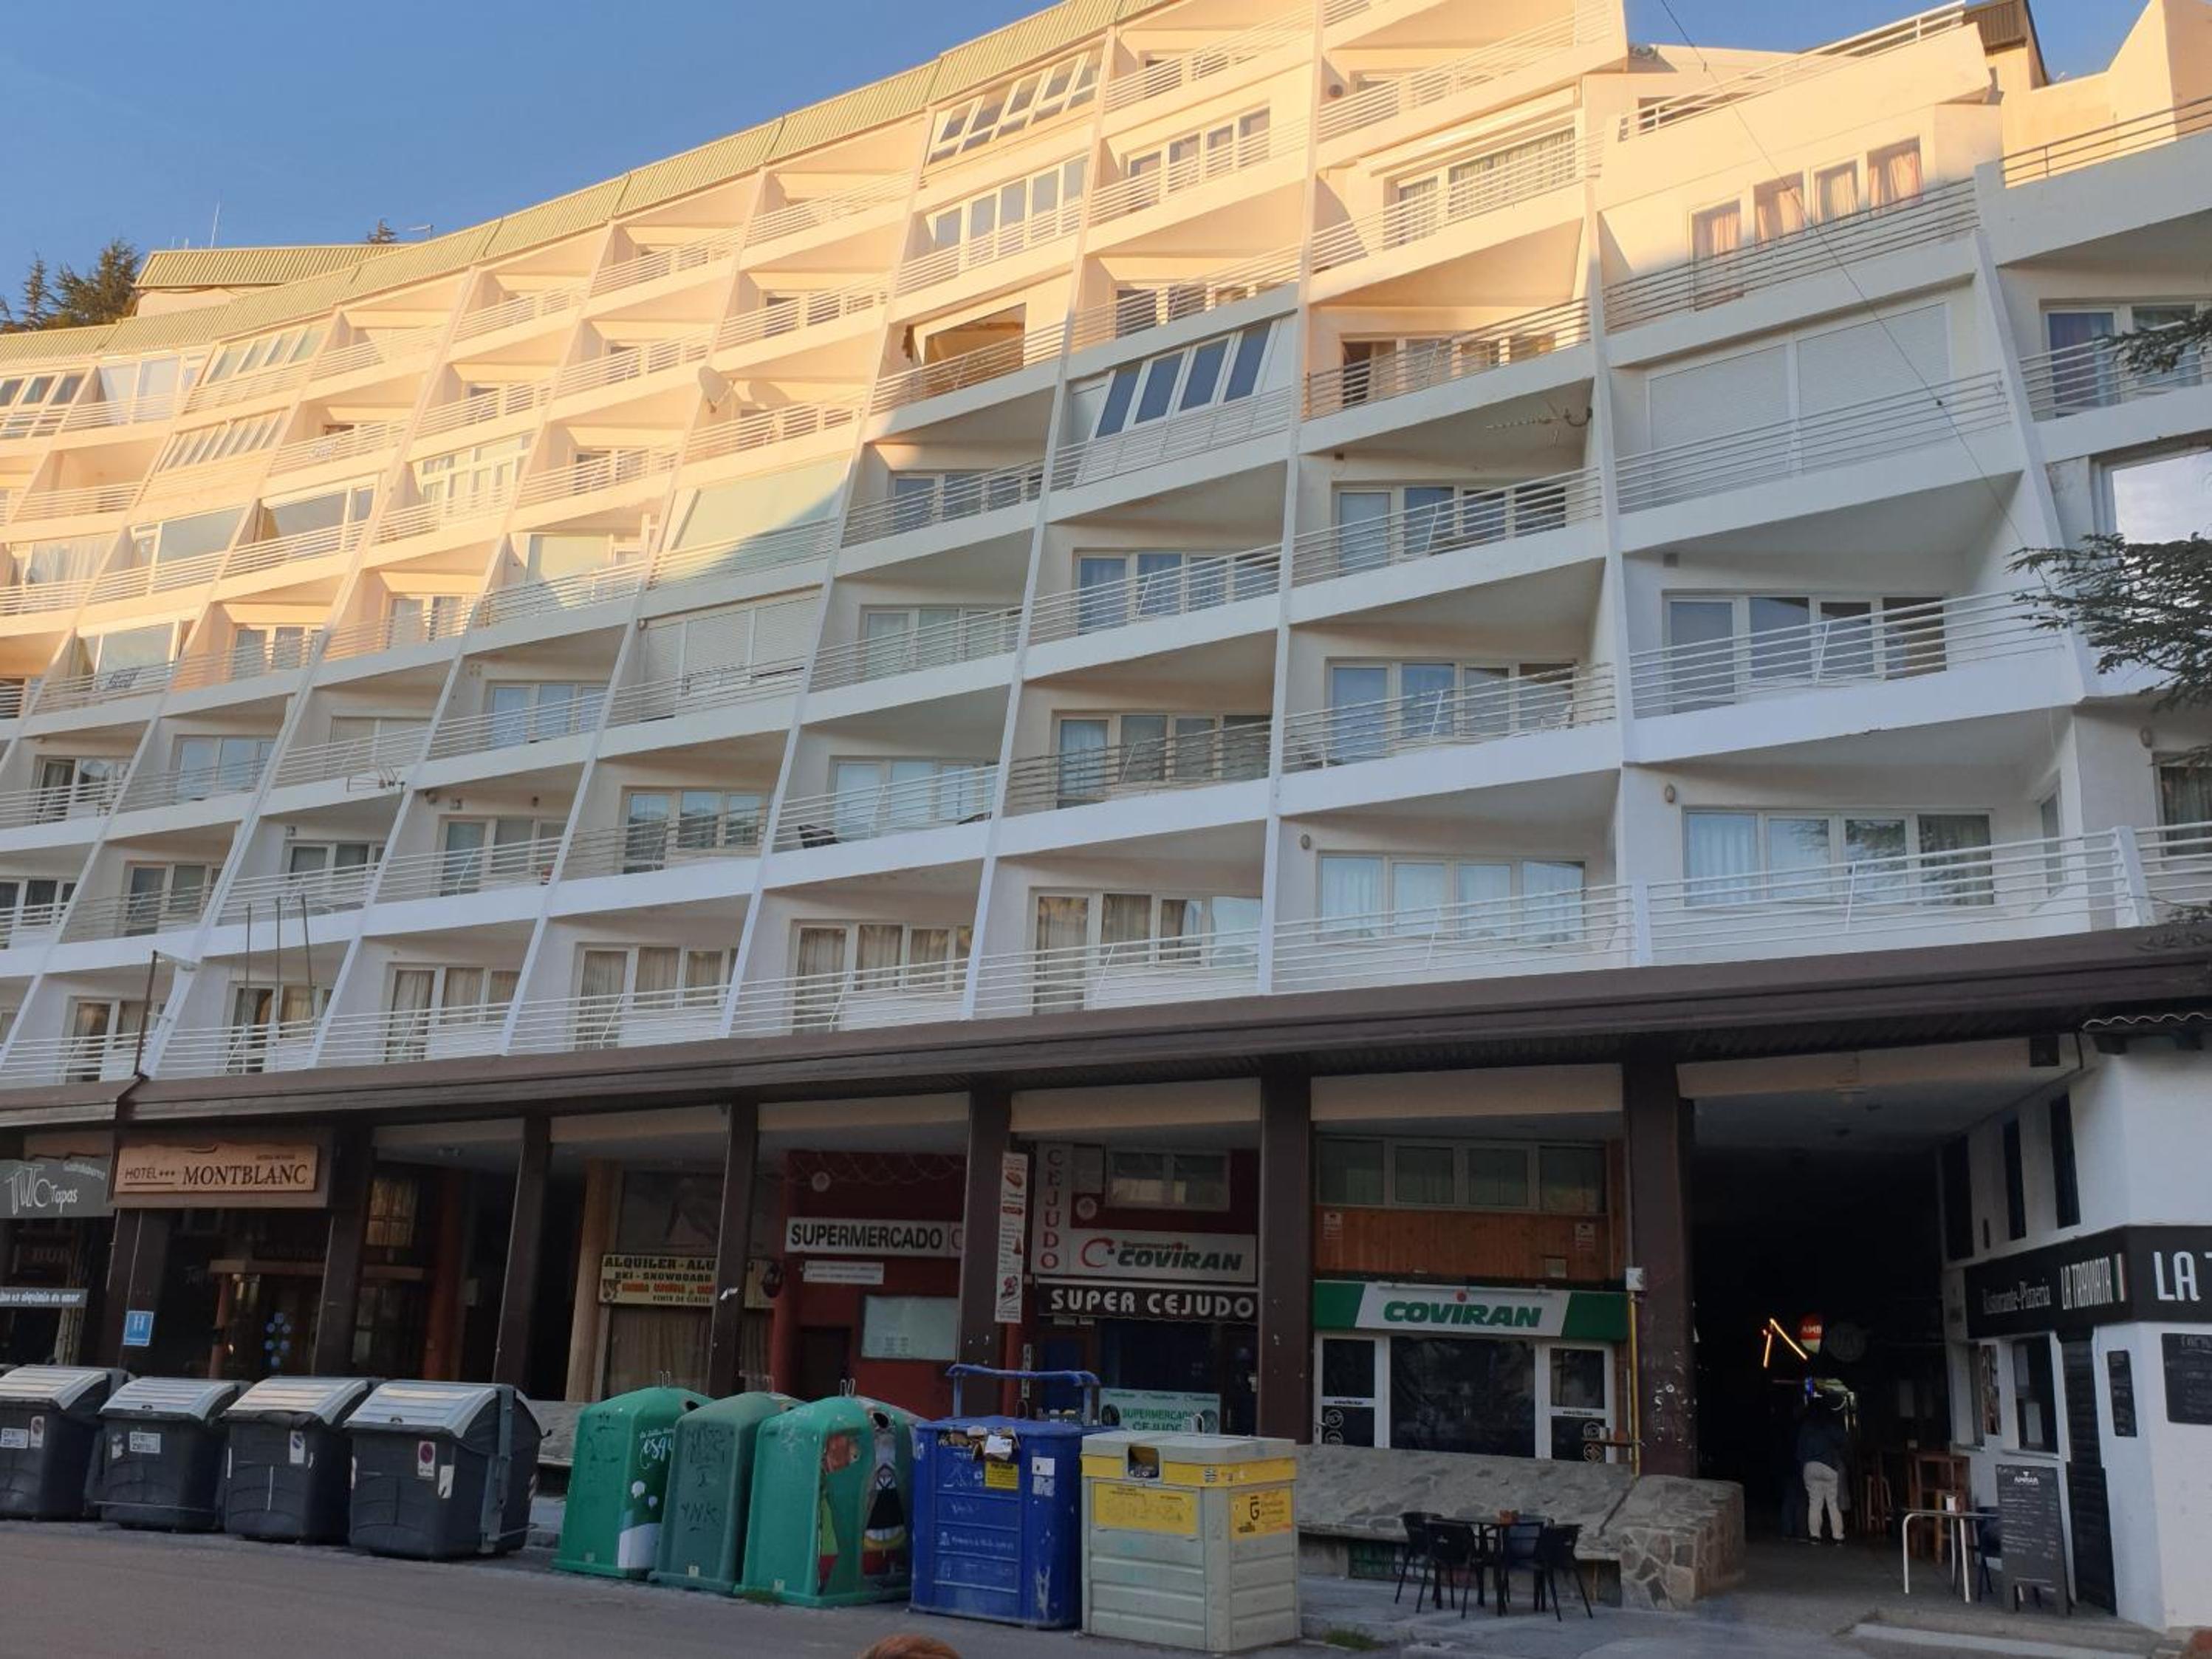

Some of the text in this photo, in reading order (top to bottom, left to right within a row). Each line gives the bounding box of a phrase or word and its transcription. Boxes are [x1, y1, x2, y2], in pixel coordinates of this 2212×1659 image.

[124, 1164, 308, 1185] HOTEL MONTBLANC
[51, 1184, 78, 1214] Tapas
[791, 1224, 943, 1250] SUPERMERCADO
[604, 1256, 677, 1269] ALQUILER
[1117, 1248, 1243, 1271] COVIRAN
[2060, 1265, 2072, 1310] LA
[2071, 1256, 2114, 1309] TRAVIATA
[2153, 1251, 2202, 1301] LA
[1050, 1288, 1135, 1313] SUPER
[1147, 1292, 1255, 1318] CEJUDO
[1383, 1299, 1542, 1327] COVIRAN
